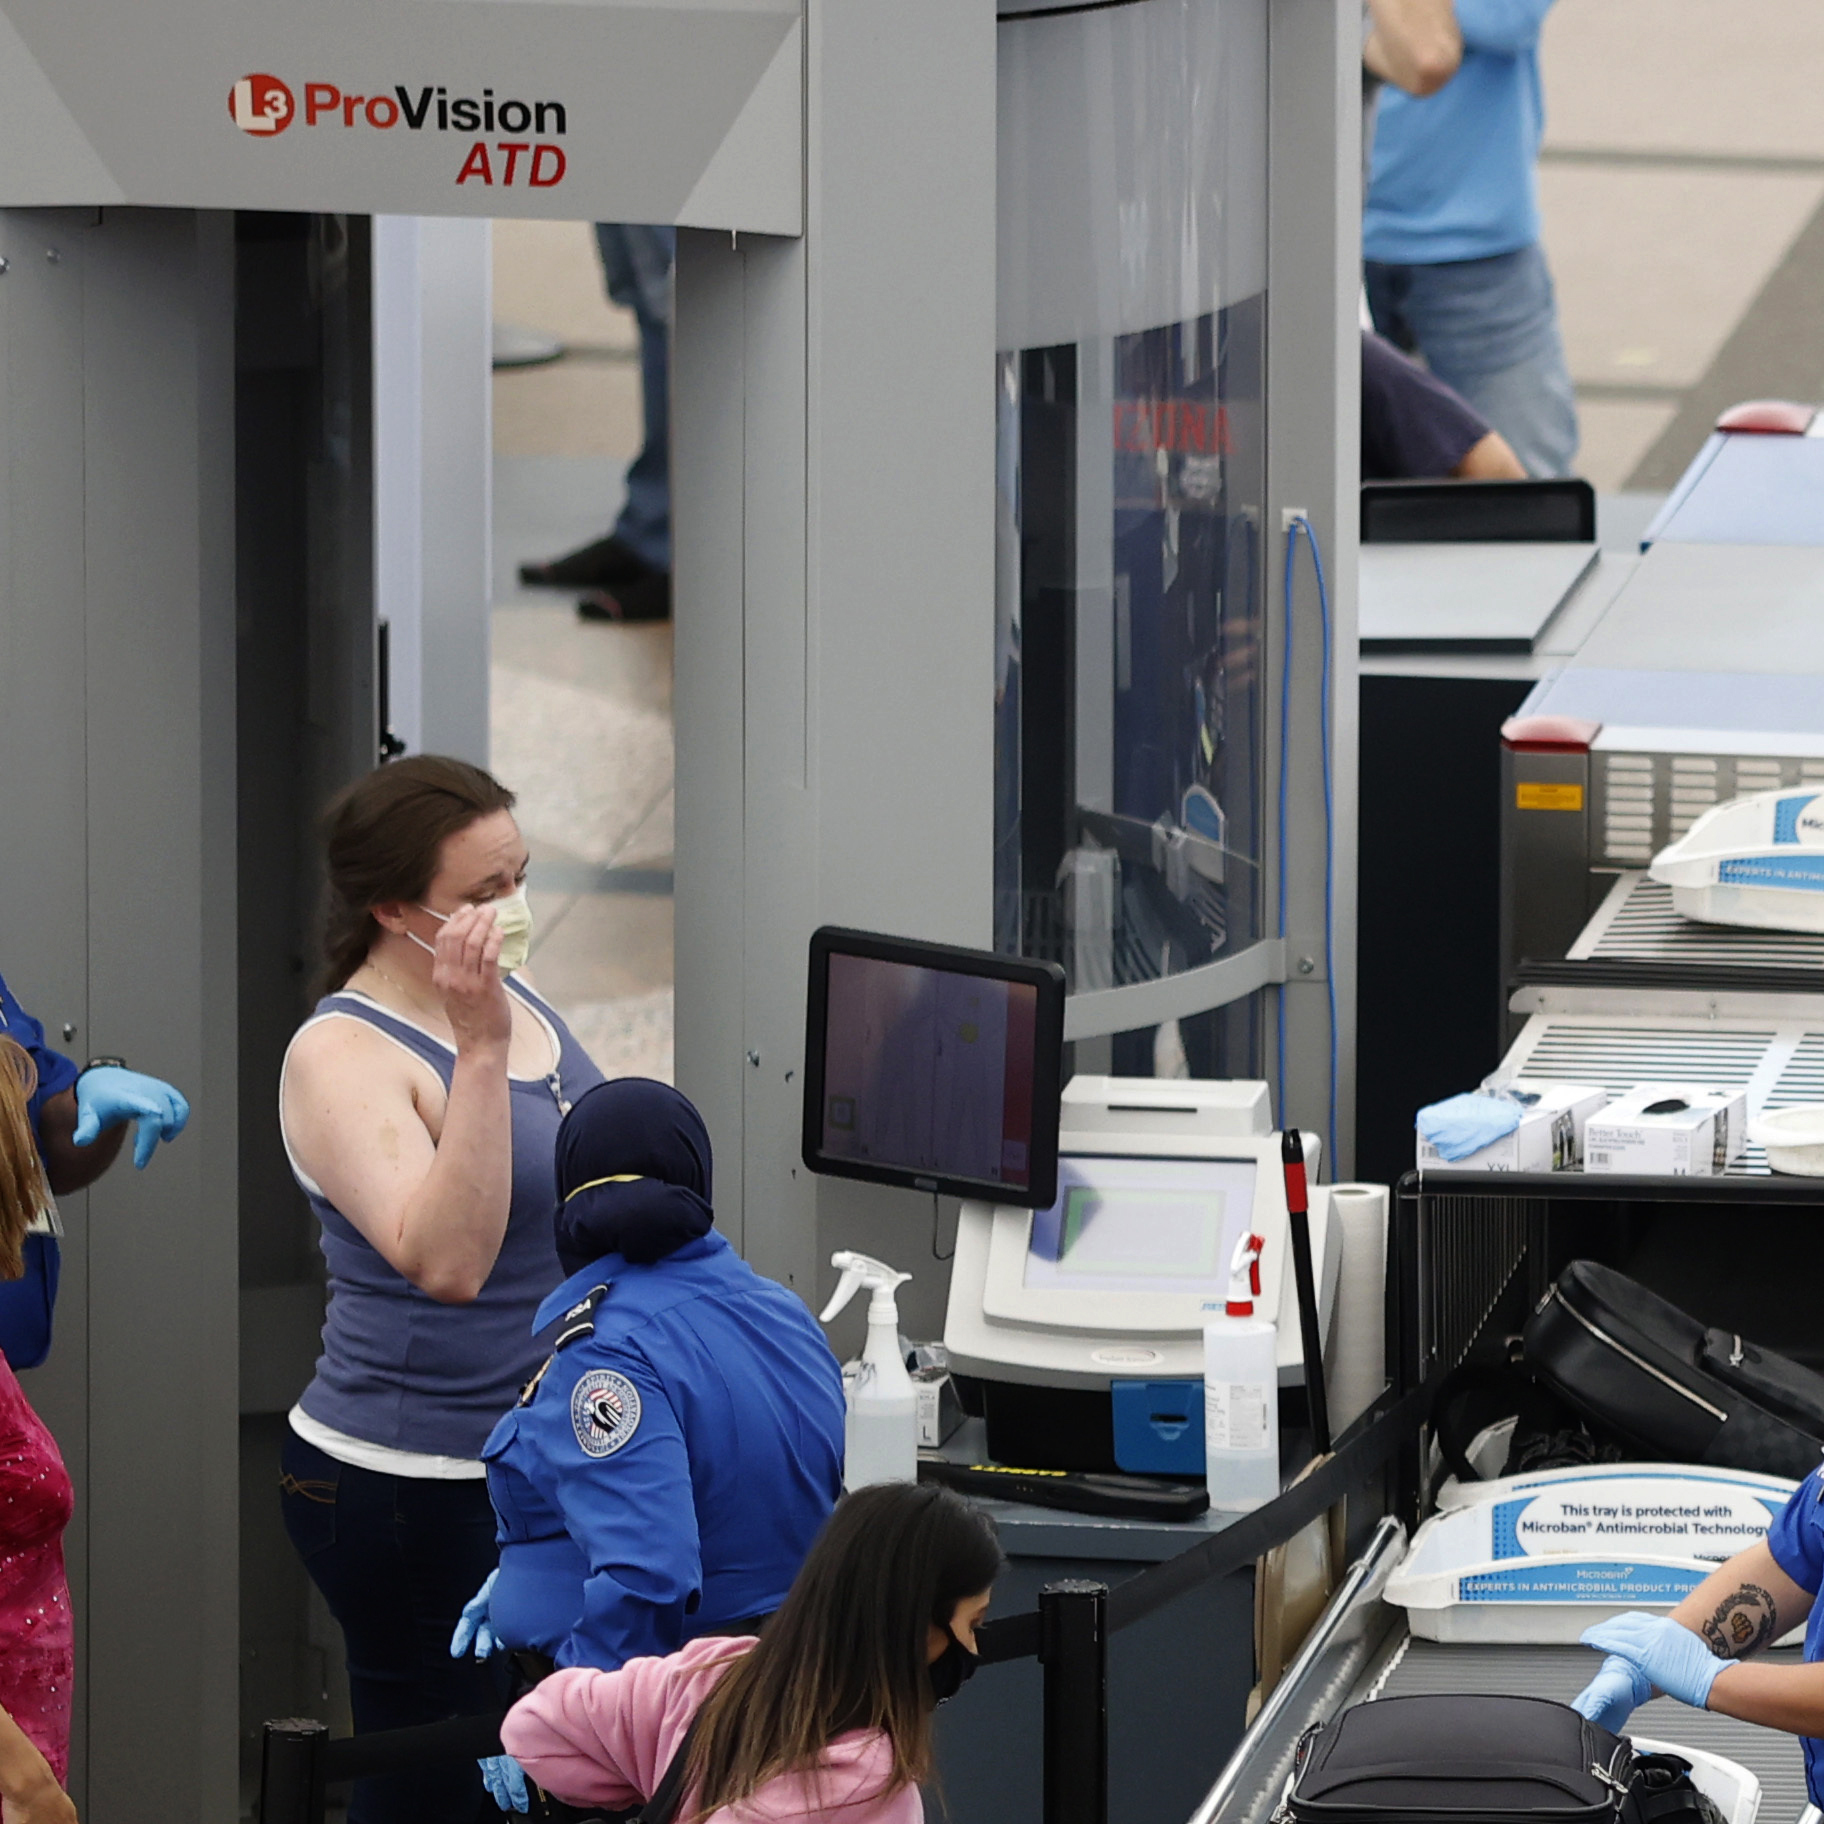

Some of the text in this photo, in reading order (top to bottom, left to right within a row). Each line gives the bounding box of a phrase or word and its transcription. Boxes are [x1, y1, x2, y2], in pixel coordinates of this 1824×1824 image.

[304, 81, 567, 135] ProVision
[455, 142, 567, 188] ATD
[922, 1425, 932, 1440] L
[1560, 1503, 1732, 1522] This tray is protected with
[1596, 1521, 1688, 1536] Antimicrobial
[1467, 1582, 1515, 1592] EXPERTS
[1518, 1583, 1530, 1592] IN
[1532, 1582, 1617, 1593] ANTIMICROBIAL
[1620, 1583, 1671, 1593] PRODUCT
